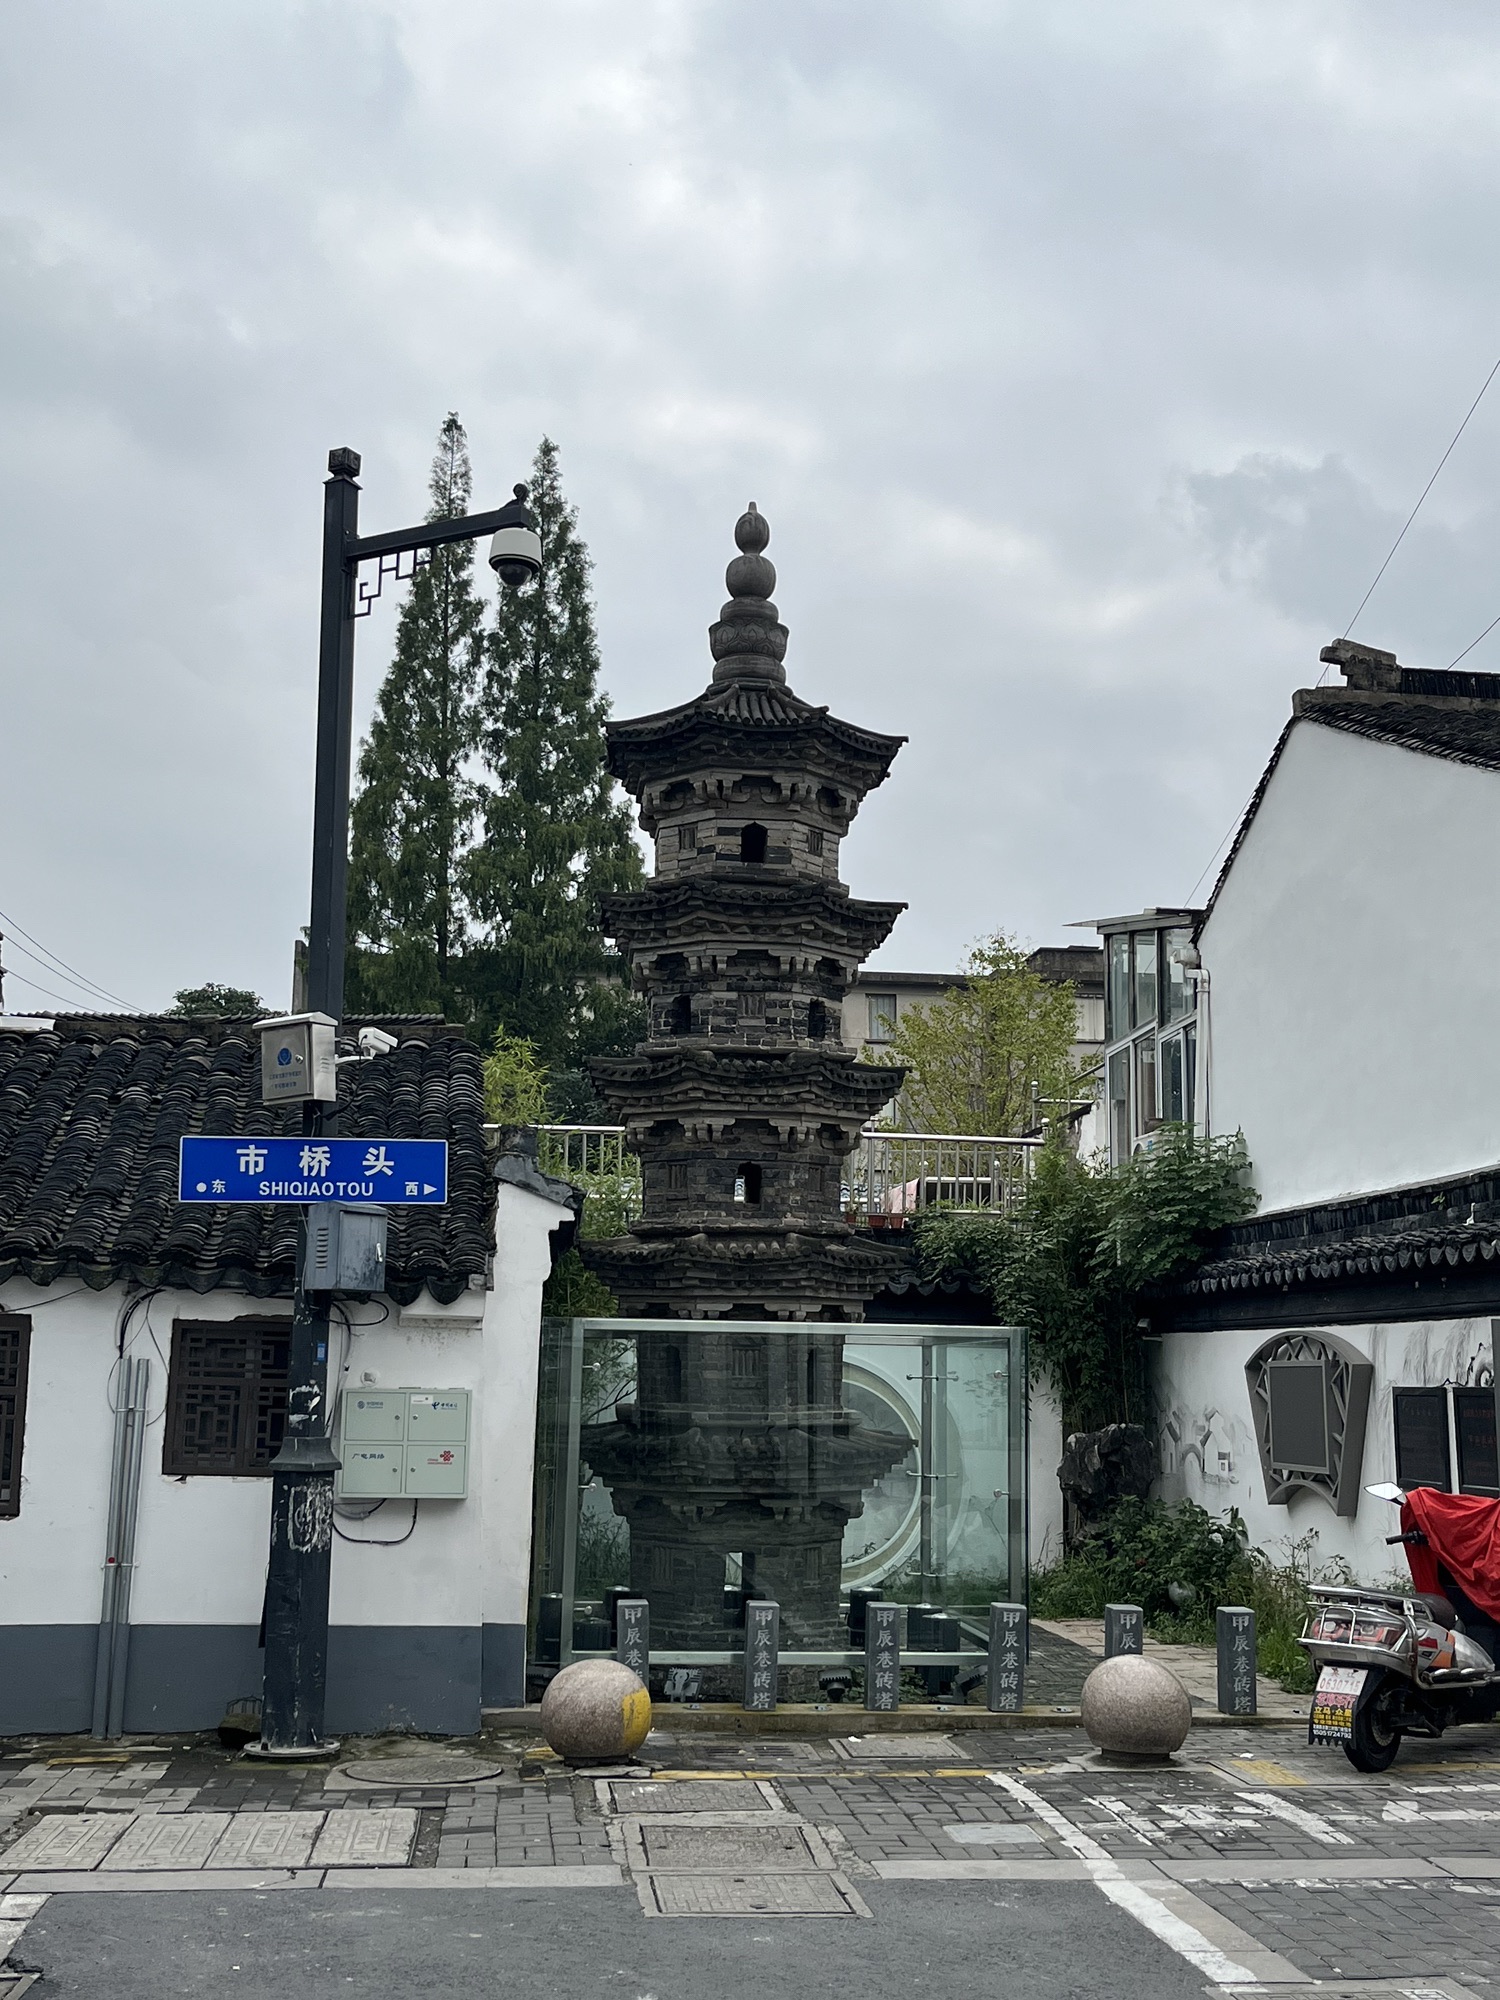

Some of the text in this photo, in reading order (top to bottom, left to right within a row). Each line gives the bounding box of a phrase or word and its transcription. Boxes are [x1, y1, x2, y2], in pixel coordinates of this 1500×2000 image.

[212, 1179, 226, 1193] 东
[236, 1144, 395, 1177] 市桥头
[259, 1181, 374, 1196] SHIQIAOTOU
[405, 1181, 419, 1196] 西
[624, 1607, 643, 1679] 甲辰巷
[1120, 1613, 1137, 1649] 甲辰
[752, 1609, 774, 1709] 甲辰巷砖塔
[874, 1610, 895, 1710] 甲辰巷砖塔
[1000, 1611, 1020, 1710] 甲辰巷砖塔
[1232, 1615, 1251, 1712] 甲辰巷砖塔
